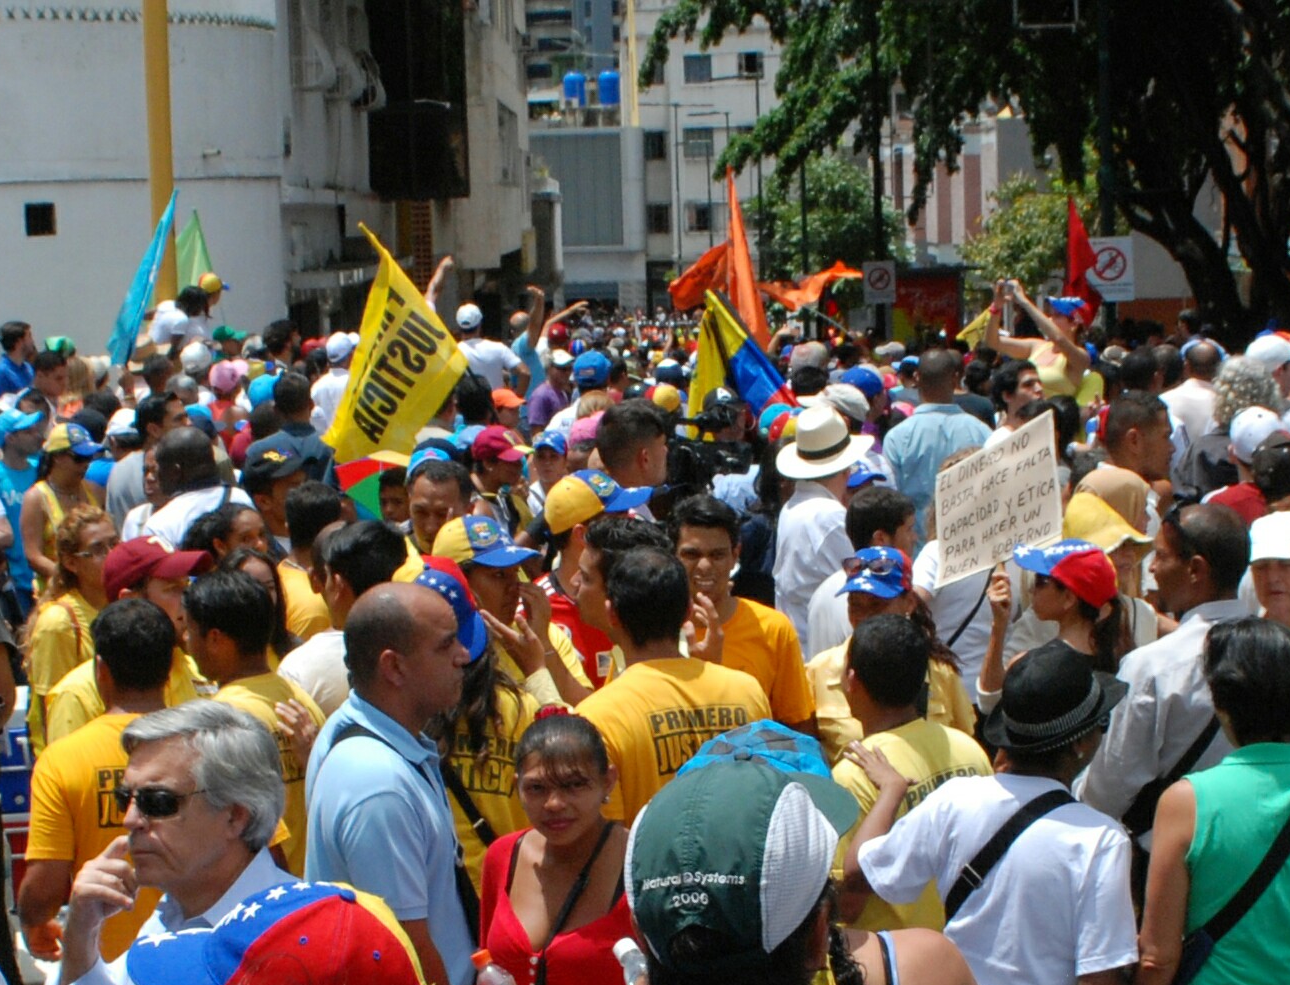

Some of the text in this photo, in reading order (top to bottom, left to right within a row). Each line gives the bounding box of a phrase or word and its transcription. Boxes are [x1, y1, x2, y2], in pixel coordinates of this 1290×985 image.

[940, 473, 952, 492] EL
[1011, 432, 1030, 454] NO
[981, 467, 1009, 496] HACE
[1014, 447, 1052, 476] FALTA
[943, 499, 999, 541] CAPACIDAD
[1005, 497, 1013, 516] Y
[945, 505, 1041, 562] PARA HACER UN
[943, 556, 979, 579] BUEN
[642, 873, 682, 890] Natural
[694, 871, 745, 885] Systems
[672, 892, 709, 907] 2006
